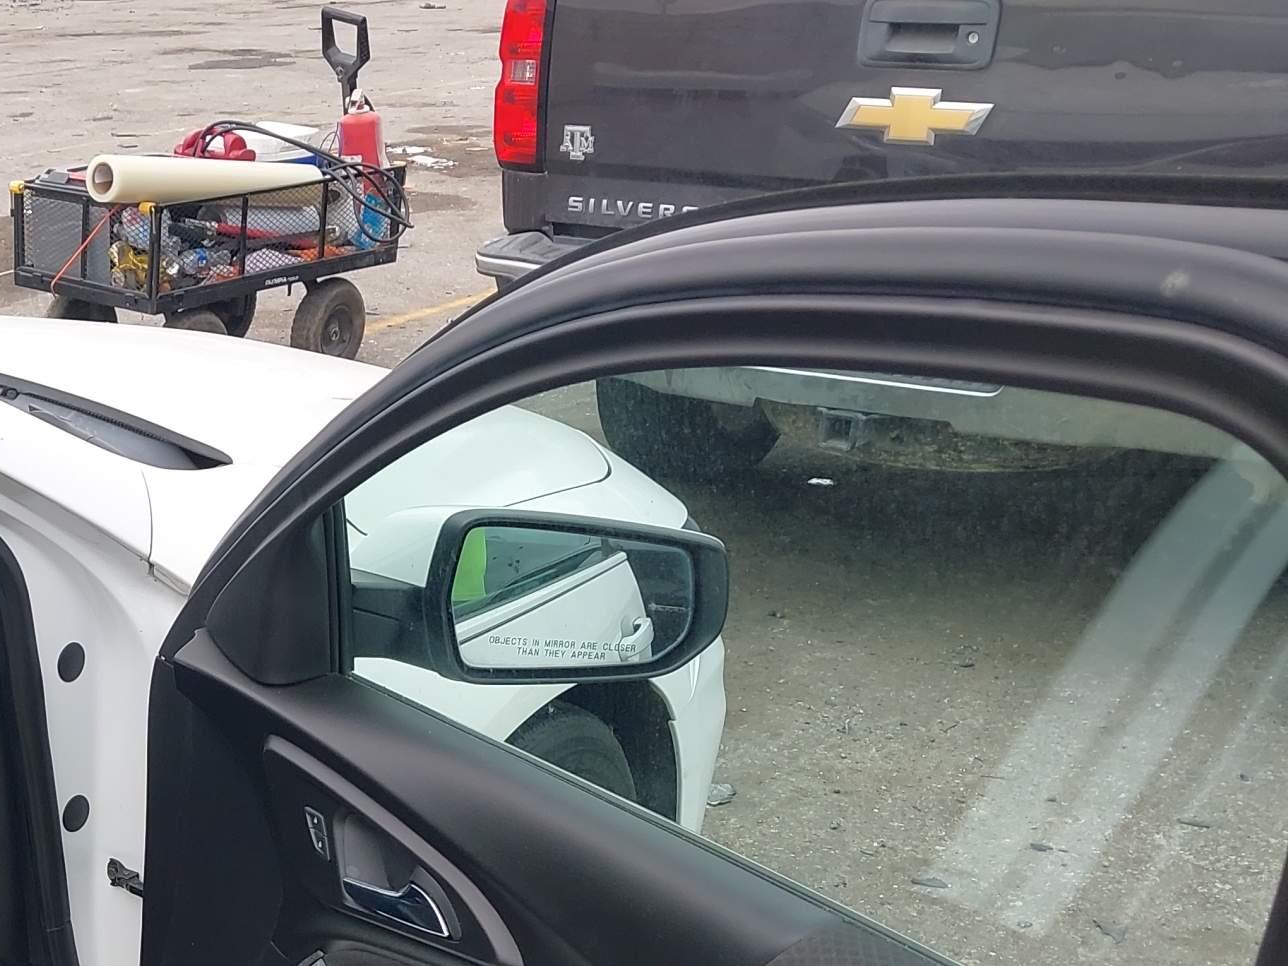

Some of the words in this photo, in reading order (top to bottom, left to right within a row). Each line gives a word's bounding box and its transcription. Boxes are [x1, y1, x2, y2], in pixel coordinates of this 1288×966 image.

[488, 636, 527, 646] OBJECTS
[532, 639, 540, 647] IN
[544, 640, 576, 649] MIRROR
[580, 641, 598, 651] ARE
[602, 642, 637, 653] CLOSER
[517, 646, 540, 657] THAN
[544, 649, 566, 658] THEY
[571, 651, 606, 660] APPEAR
